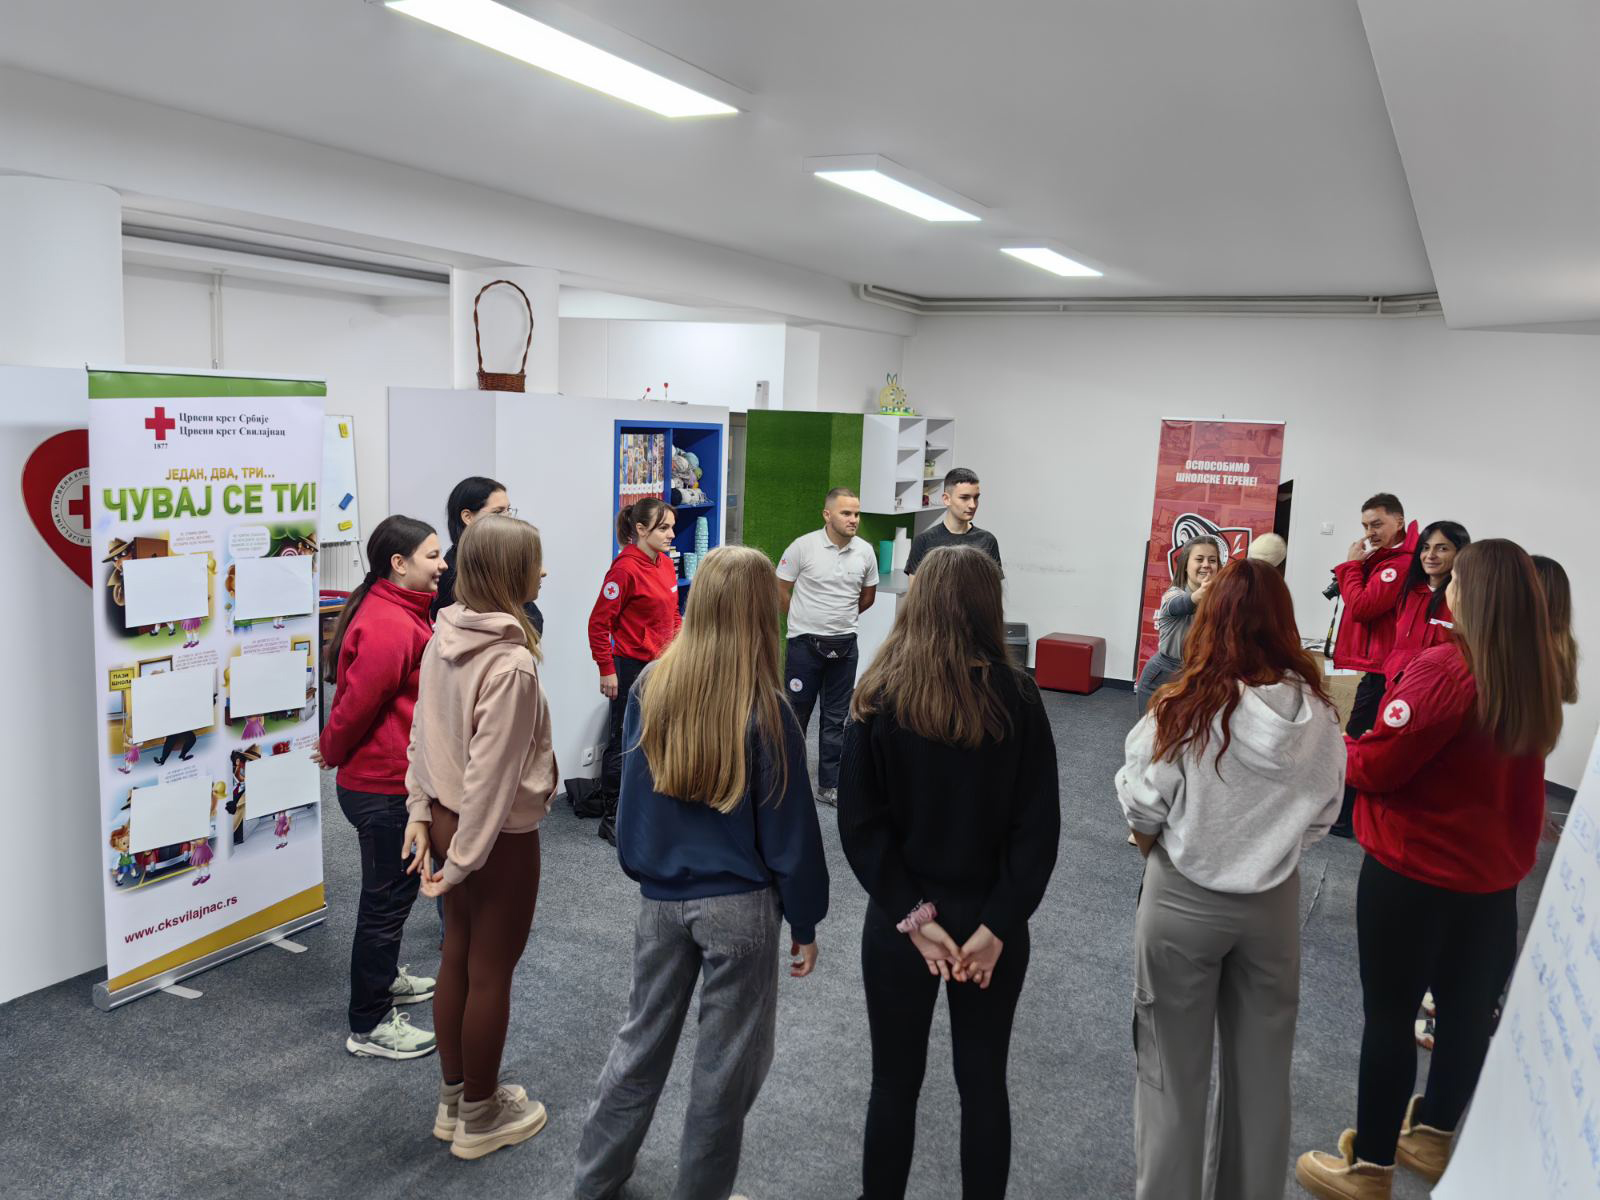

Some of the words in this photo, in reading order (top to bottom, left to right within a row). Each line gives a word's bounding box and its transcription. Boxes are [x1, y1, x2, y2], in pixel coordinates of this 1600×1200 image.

[179, 412, 214, 424] Црвени
[215, 415, 237, 424] крст
[239, 413, 269, 425] Србије
[180, 426, 214, 437] Црвени
[216, 428, 237, 437] крст
[239, 427, 286, 438] Свилајнац
[1185, 459, 1250, 473] ОСПОСОБИМО
[165, 468, 207, 482] ЈЕДАН,
[210, 467, 238, 481] ДВА,
[241, 467, 275, 479] ТРИ...
[1175, 472, 1221, 485] ШКОЛСКЕ
[1222, 474, 1258, 487] ТЕРЕНЕ!
[103, 484, 212, 521] ЧУВАЈ
[223, 483, 264, 515] СЕ
[270, 482, 317, 513] ТИ!
[124, 896, 238, 943] www.cksvilajnac.rs
